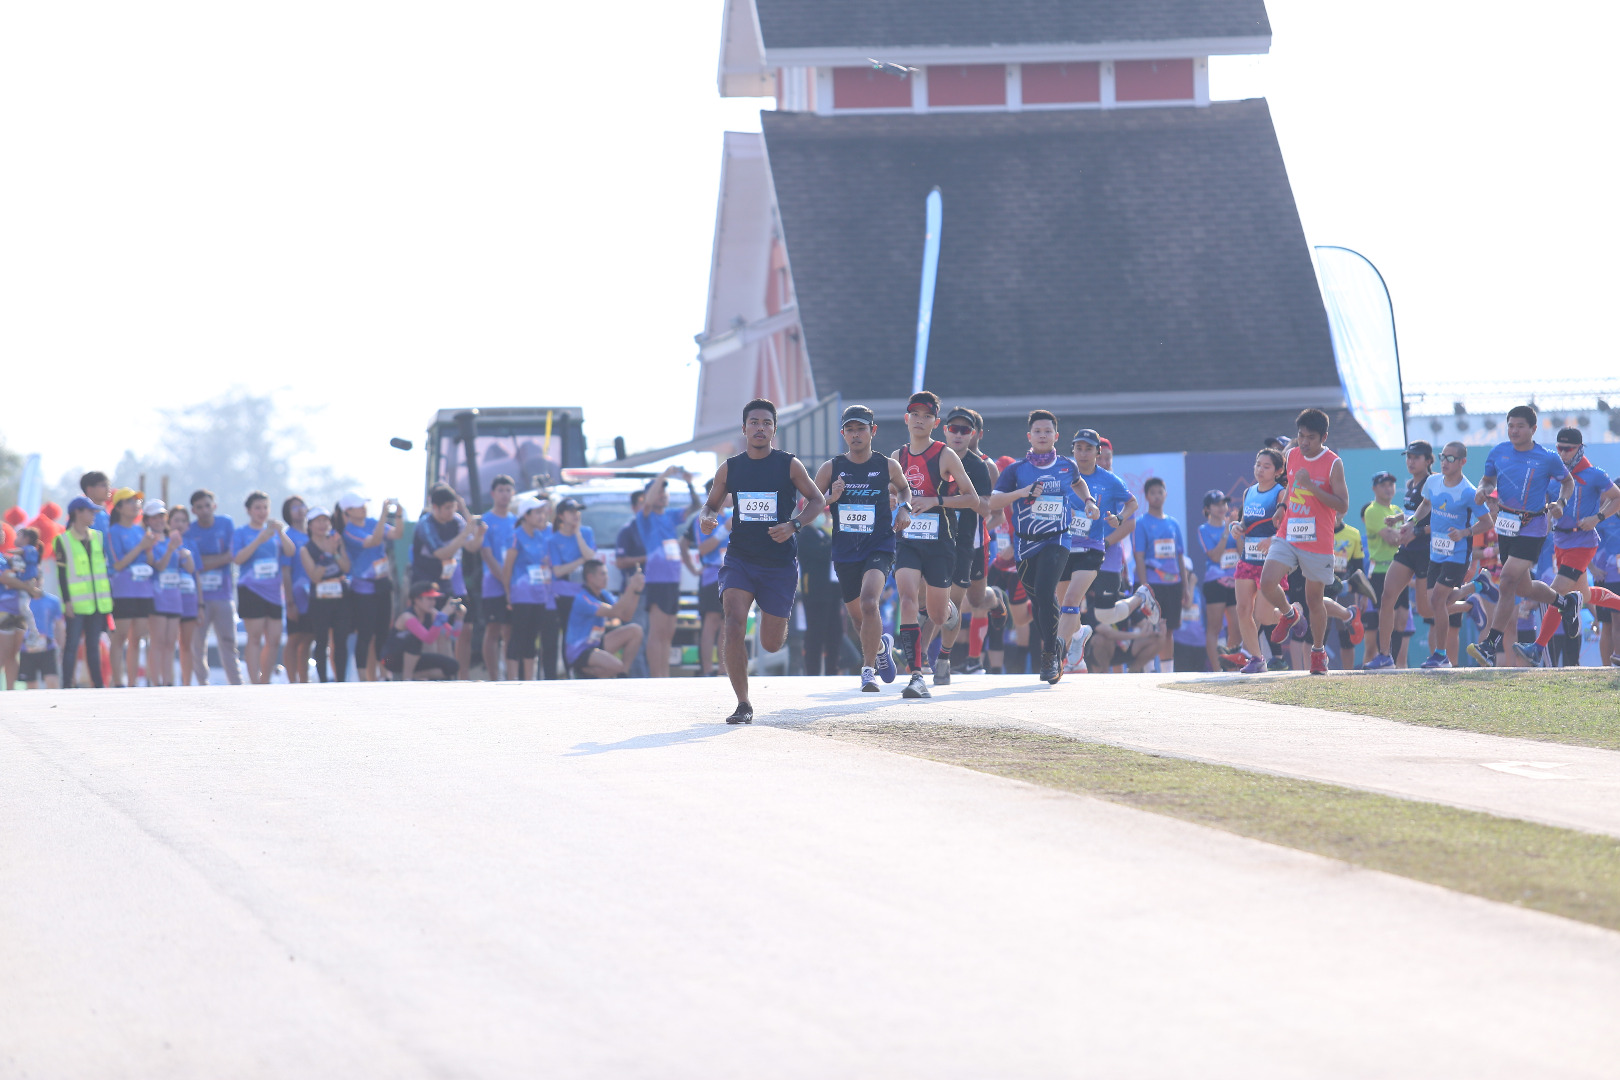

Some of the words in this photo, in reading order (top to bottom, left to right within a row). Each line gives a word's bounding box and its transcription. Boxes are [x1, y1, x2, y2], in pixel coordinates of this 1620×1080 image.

[746, 501, 770, 511] 6396
[1037, 503, 1060, 512] 6387
[846, 513, 867, 522] 6308
[1070, 517, 1086, 528] 056
[910, 521, 932, 531] 6361
[1292, 525, 1309, 533] 6309
[1498, 519, 1515, 529] 6264
[1434, 539, 1451, 549] 6263
